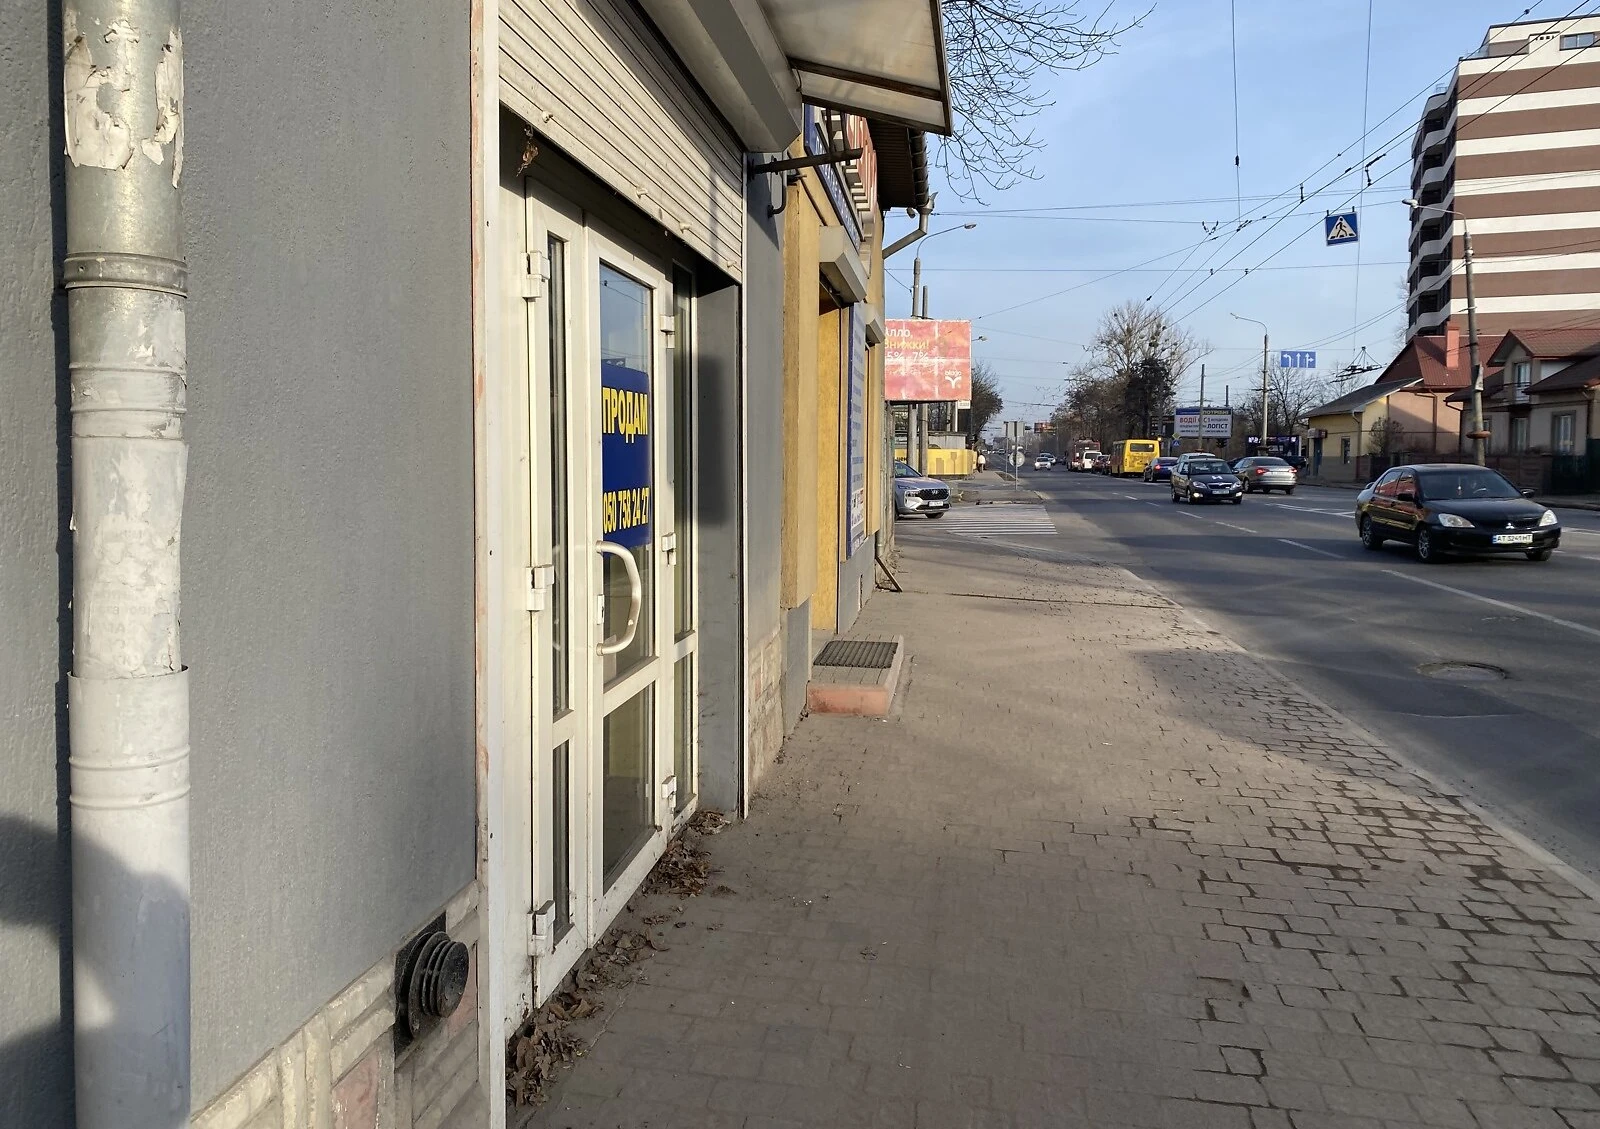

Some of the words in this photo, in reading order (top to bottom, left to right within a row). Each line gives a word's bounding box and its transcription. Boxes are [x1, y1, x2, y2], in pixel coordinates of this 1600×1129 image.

[602, 386, 648, 443] ПРОДАМ
[603, 491, 617, 534] 050
[618, 489, 631, 530] 758
[632, 487, 641, 527] 24
[641, 486, 650, 525] 27
